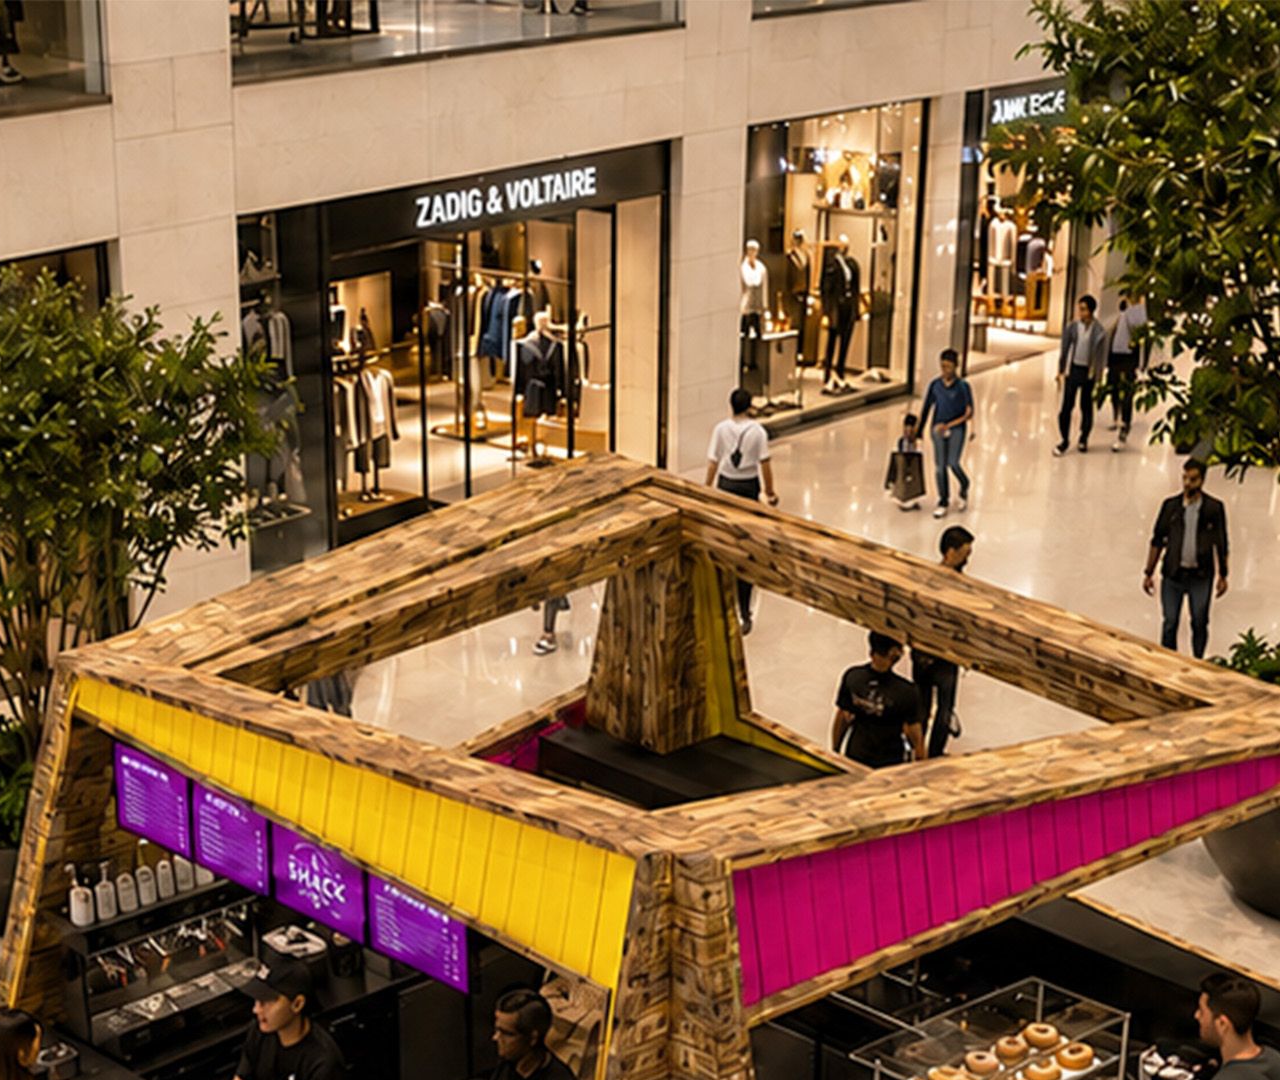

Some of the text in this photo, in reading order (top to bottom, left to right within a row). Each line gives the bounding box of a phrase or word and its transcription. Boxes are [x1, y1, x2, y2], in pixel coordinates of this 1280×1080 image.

[415, 165, 597, 228] ZADIG & VOLTAIRE
